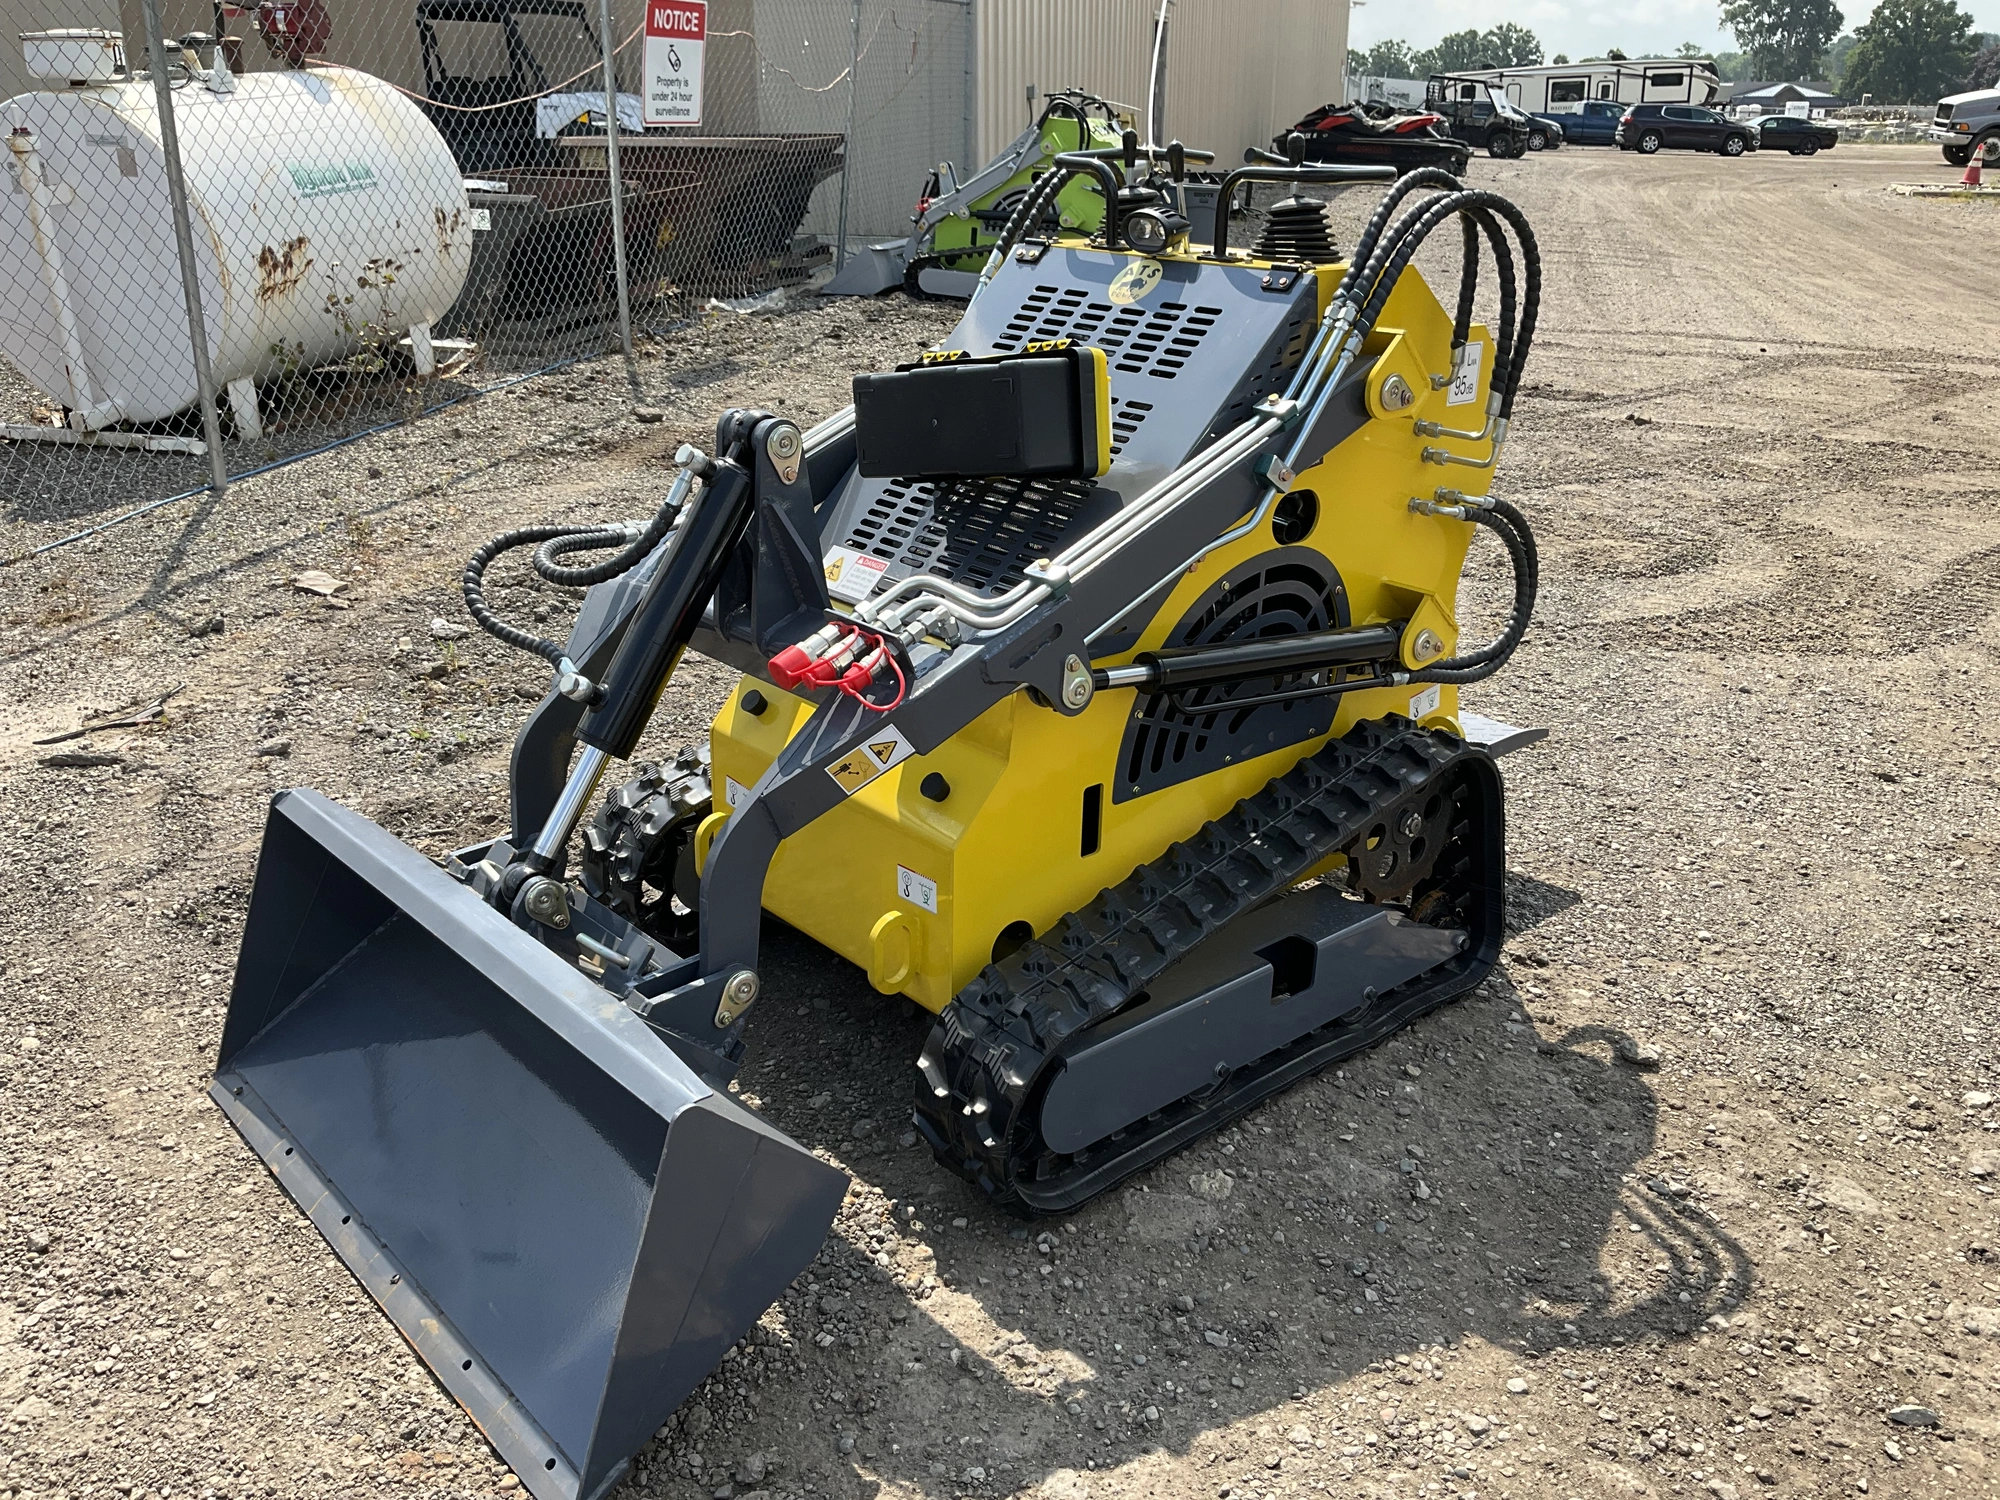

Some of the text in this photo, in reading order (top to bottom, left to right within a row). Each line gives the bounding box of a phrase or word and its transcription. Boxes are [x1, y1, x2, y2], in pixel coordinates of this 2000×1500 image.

[653, 8, 699, 31] NOTICE
[656, 76, 689, 89] Property is
[652, 91, 692, 101] under 24 hour
[655, 106, 690, 116] surveillance
[1122, 264, 1161, 279] ATS
[864, 559, 887, 571] DANGER
